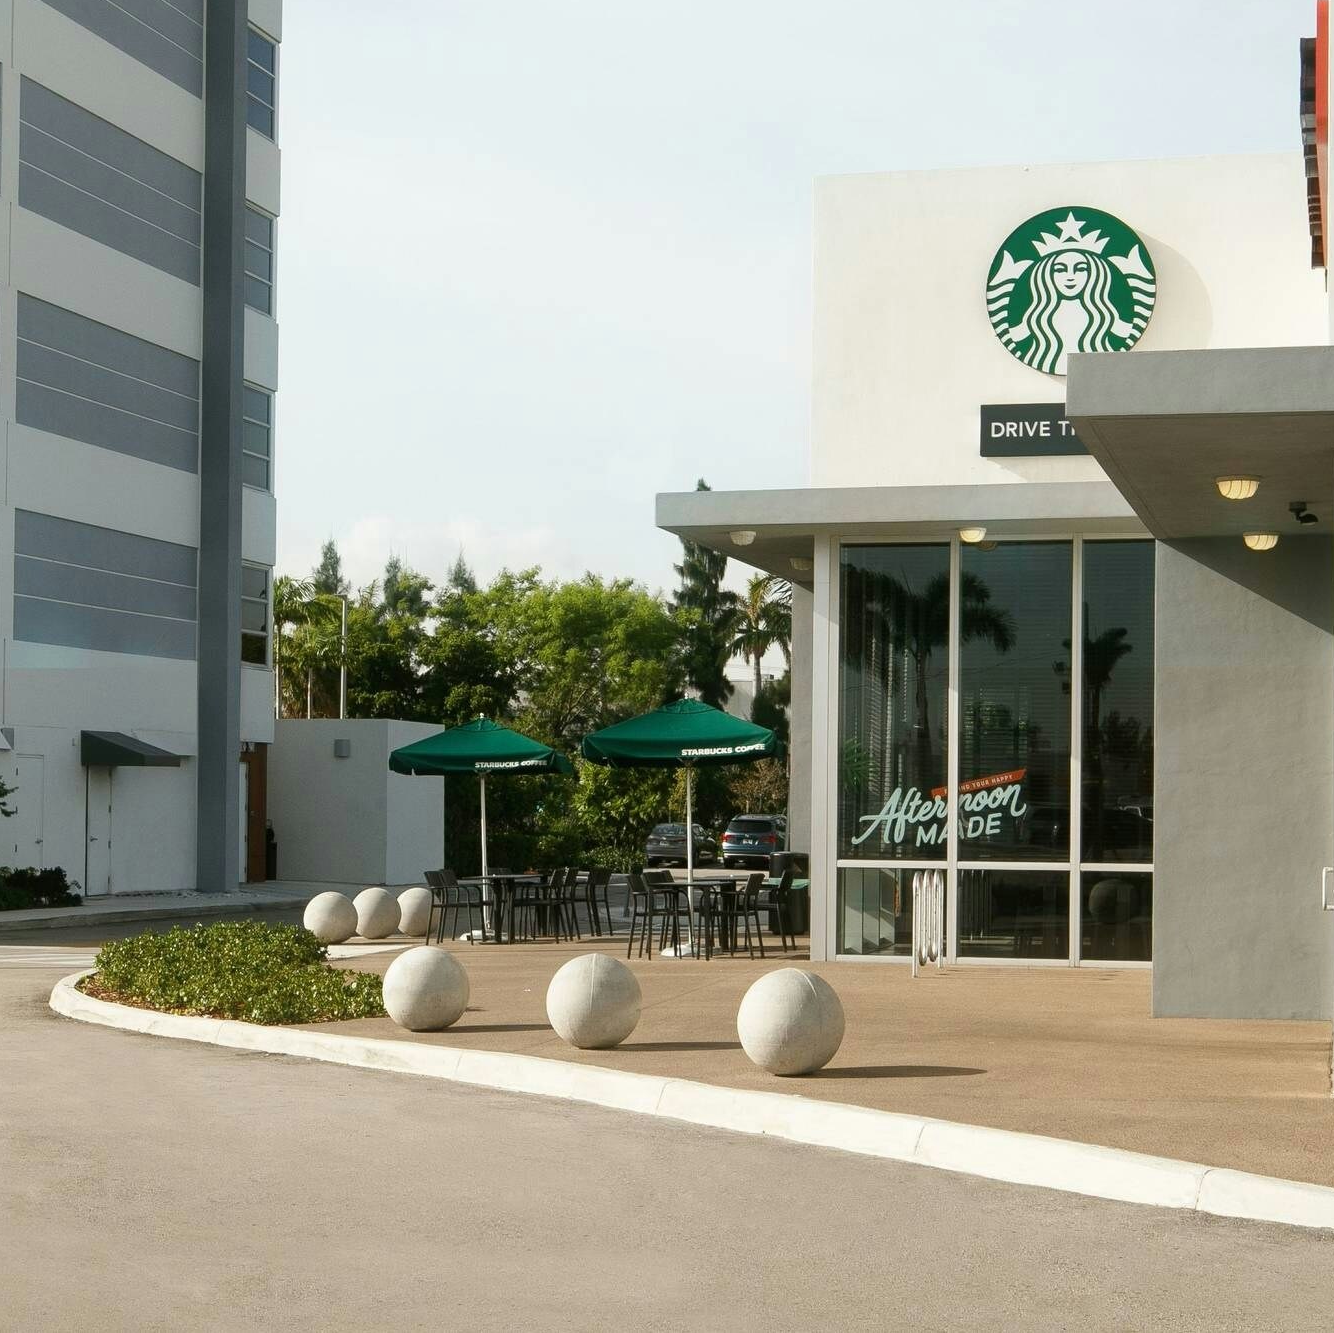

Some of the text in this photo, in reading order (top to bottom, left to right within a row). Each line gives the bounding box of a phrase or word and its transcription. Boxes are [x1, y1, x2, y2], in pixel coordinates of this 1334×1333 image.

[990, 420, 1076, 438] DRIVE T
[681, 743, 766, 756] STARBUCKS COFFEE
[971, 779, 990, 788] YOUR
[991, 774, 1013, 784] HAPPY
[851, 784, 1027, 845] Afternoon
